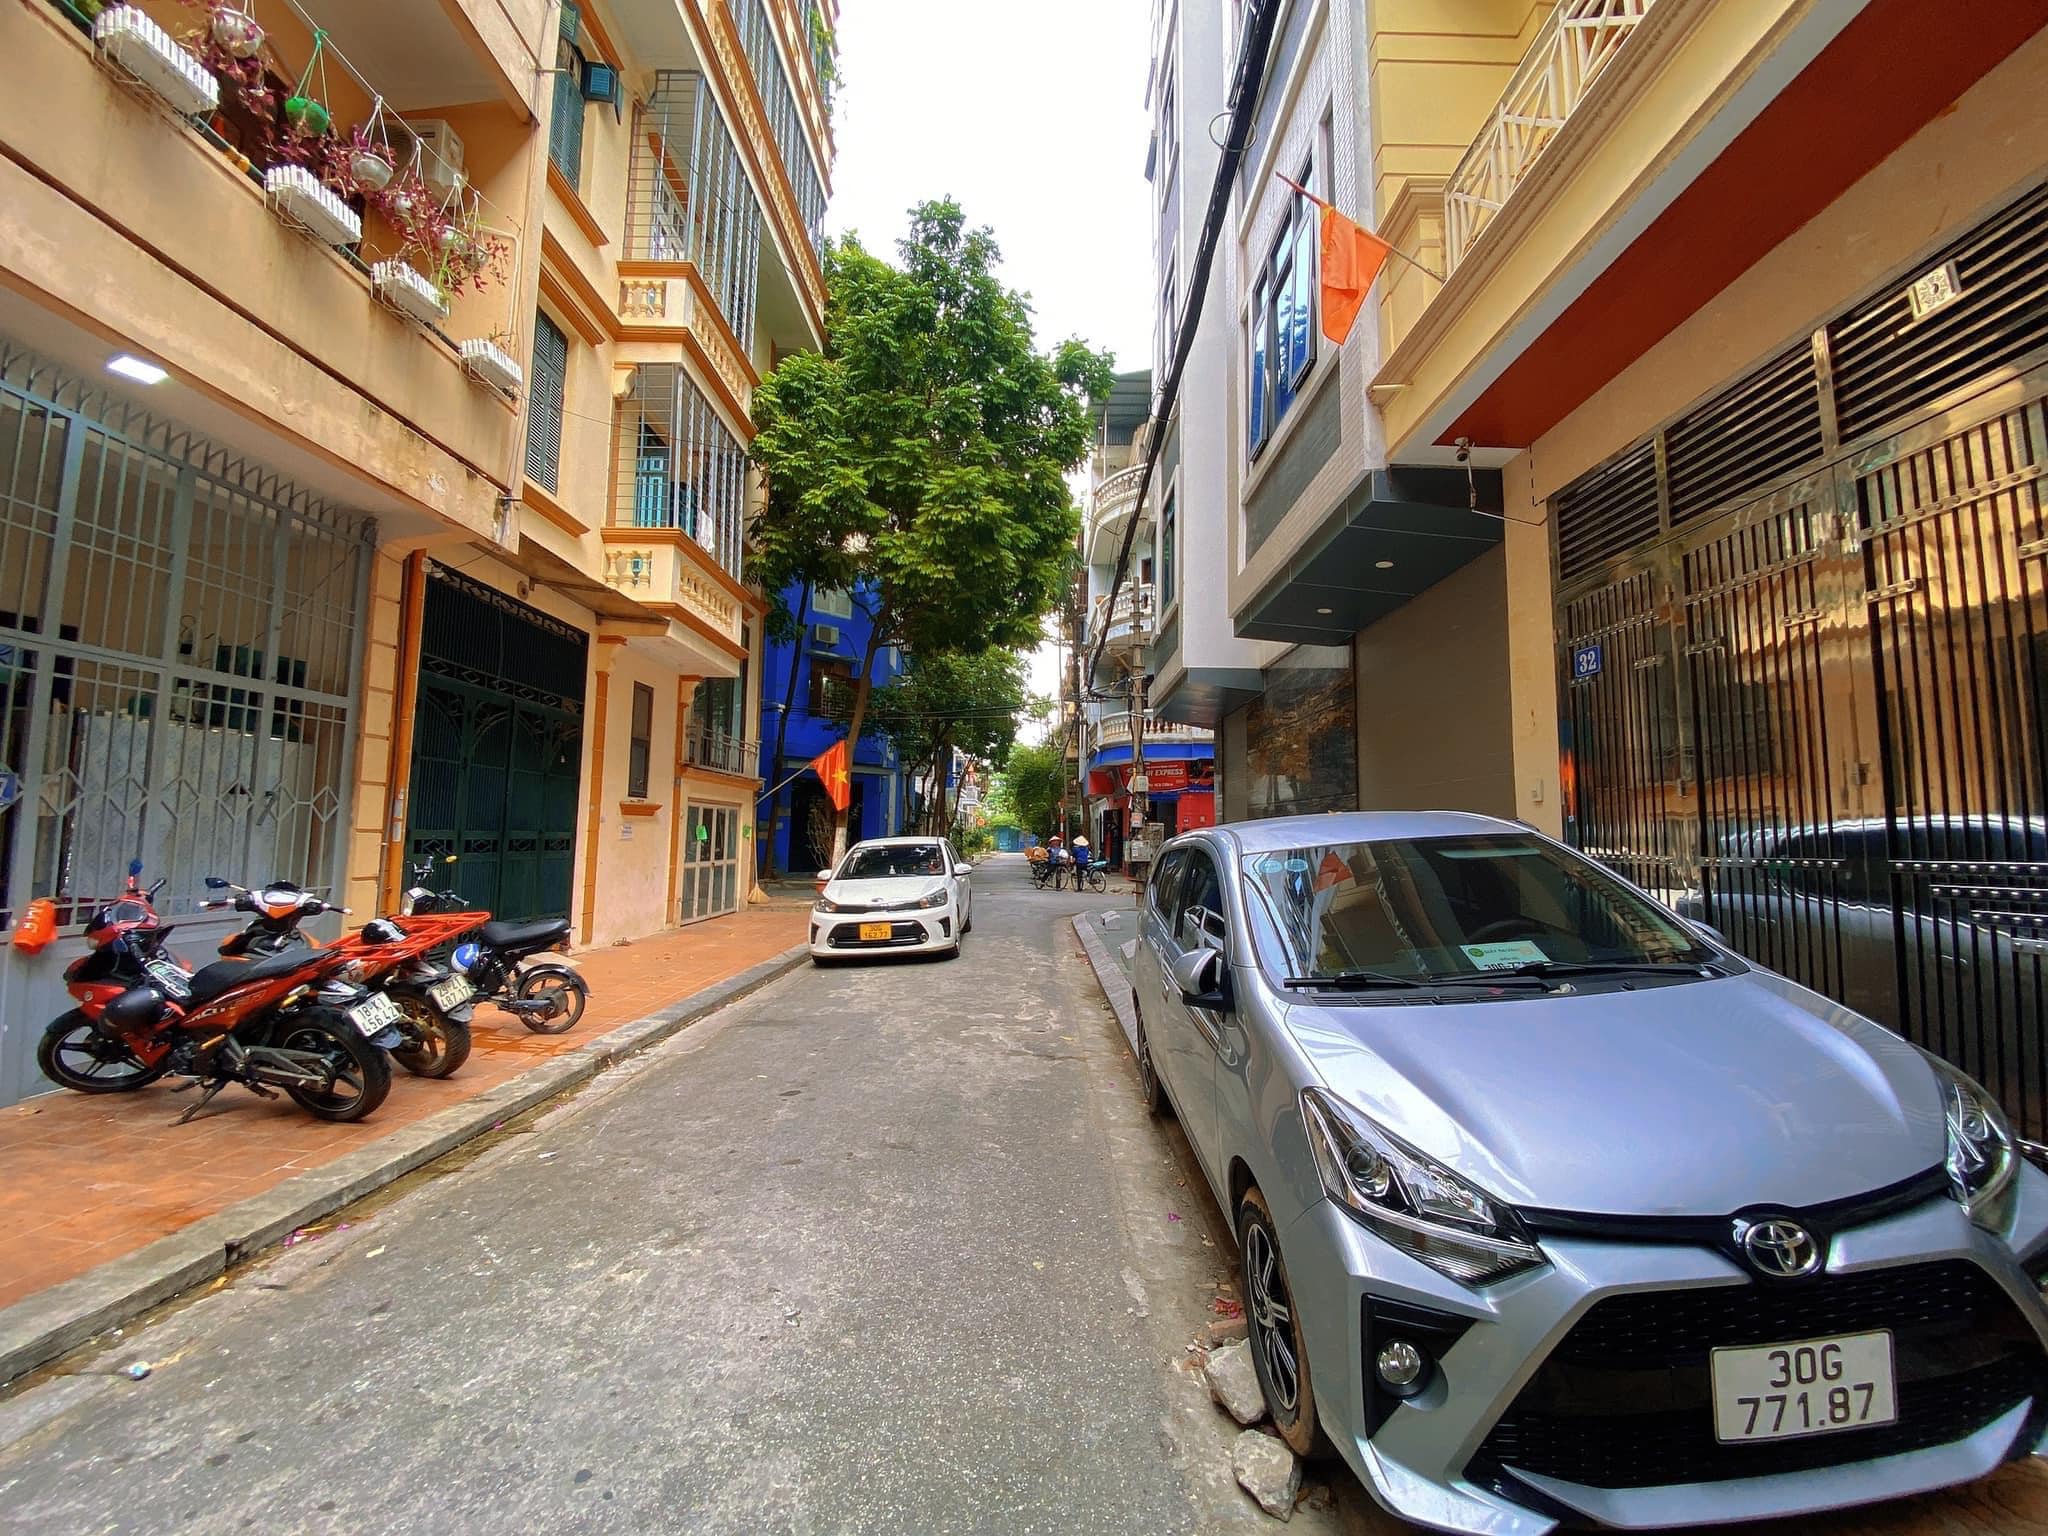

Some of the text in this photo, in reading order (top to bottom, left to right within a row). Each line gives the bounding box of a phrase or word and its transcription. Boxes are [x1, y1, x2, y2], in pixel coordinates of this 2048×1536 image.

[1579, 650, 1597, 673] 32
[1155, 768, 1184, 777] EXPRESS
[362, 1006, 398, 1033] 456.42
[1768, 1344, 1843, 1388] 30G
[1737, 1382, 1874, 1435] 771.87
